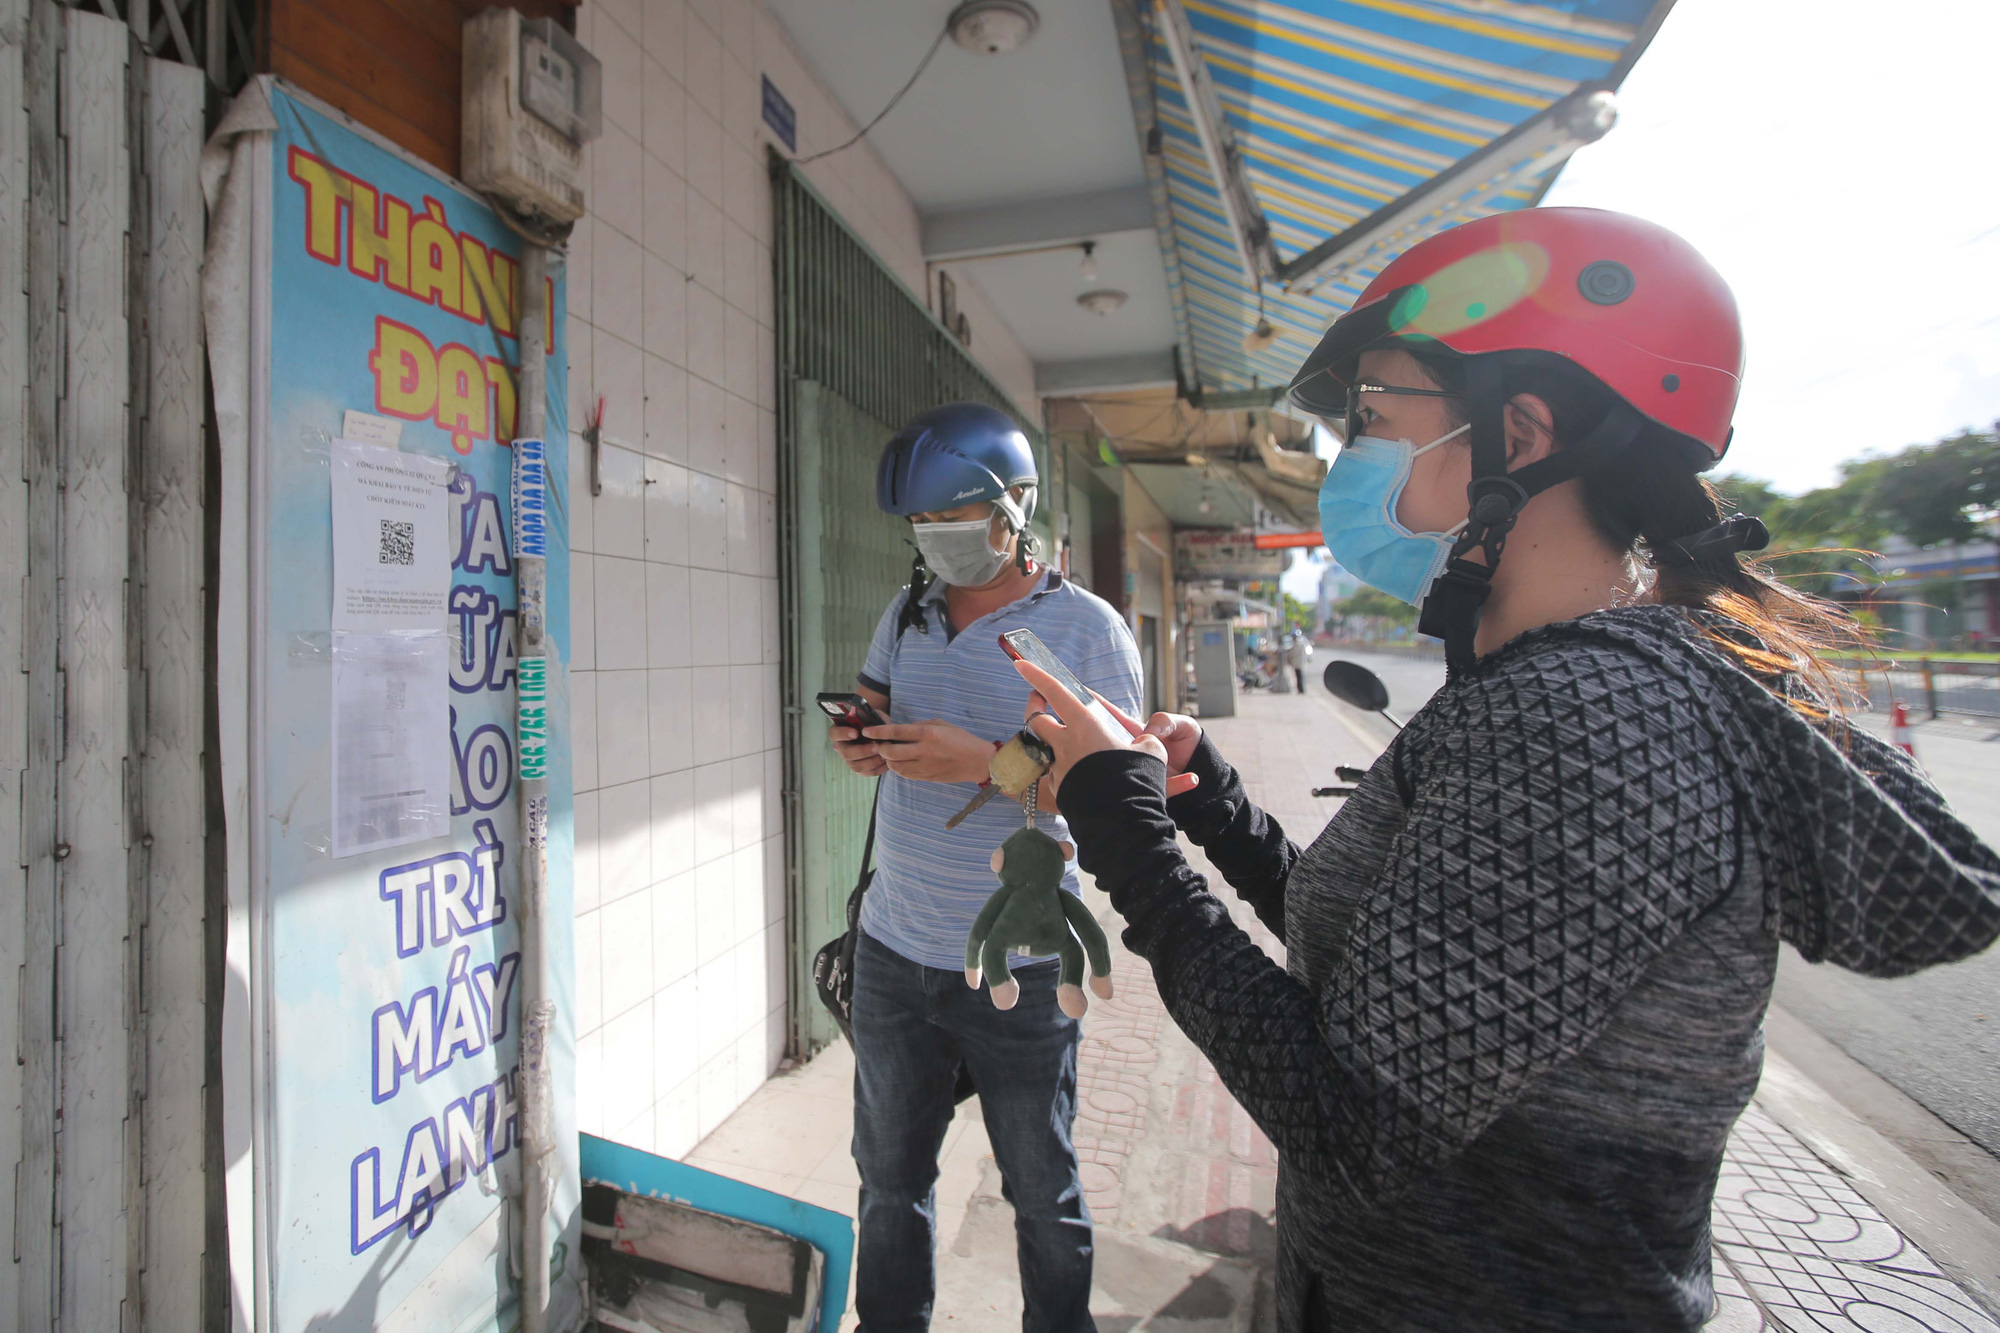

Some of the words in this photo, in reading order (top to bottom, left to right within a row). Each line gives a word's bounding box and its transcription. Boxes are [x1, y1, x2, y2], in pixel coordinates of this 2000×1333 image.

[368, 314, 519, 456] ĐẠT
[380, 818, 506, 958] TRÌ
[372, 945, 521, 1105] MÁY
[350, 1066, 522, 1256] LẠNH
